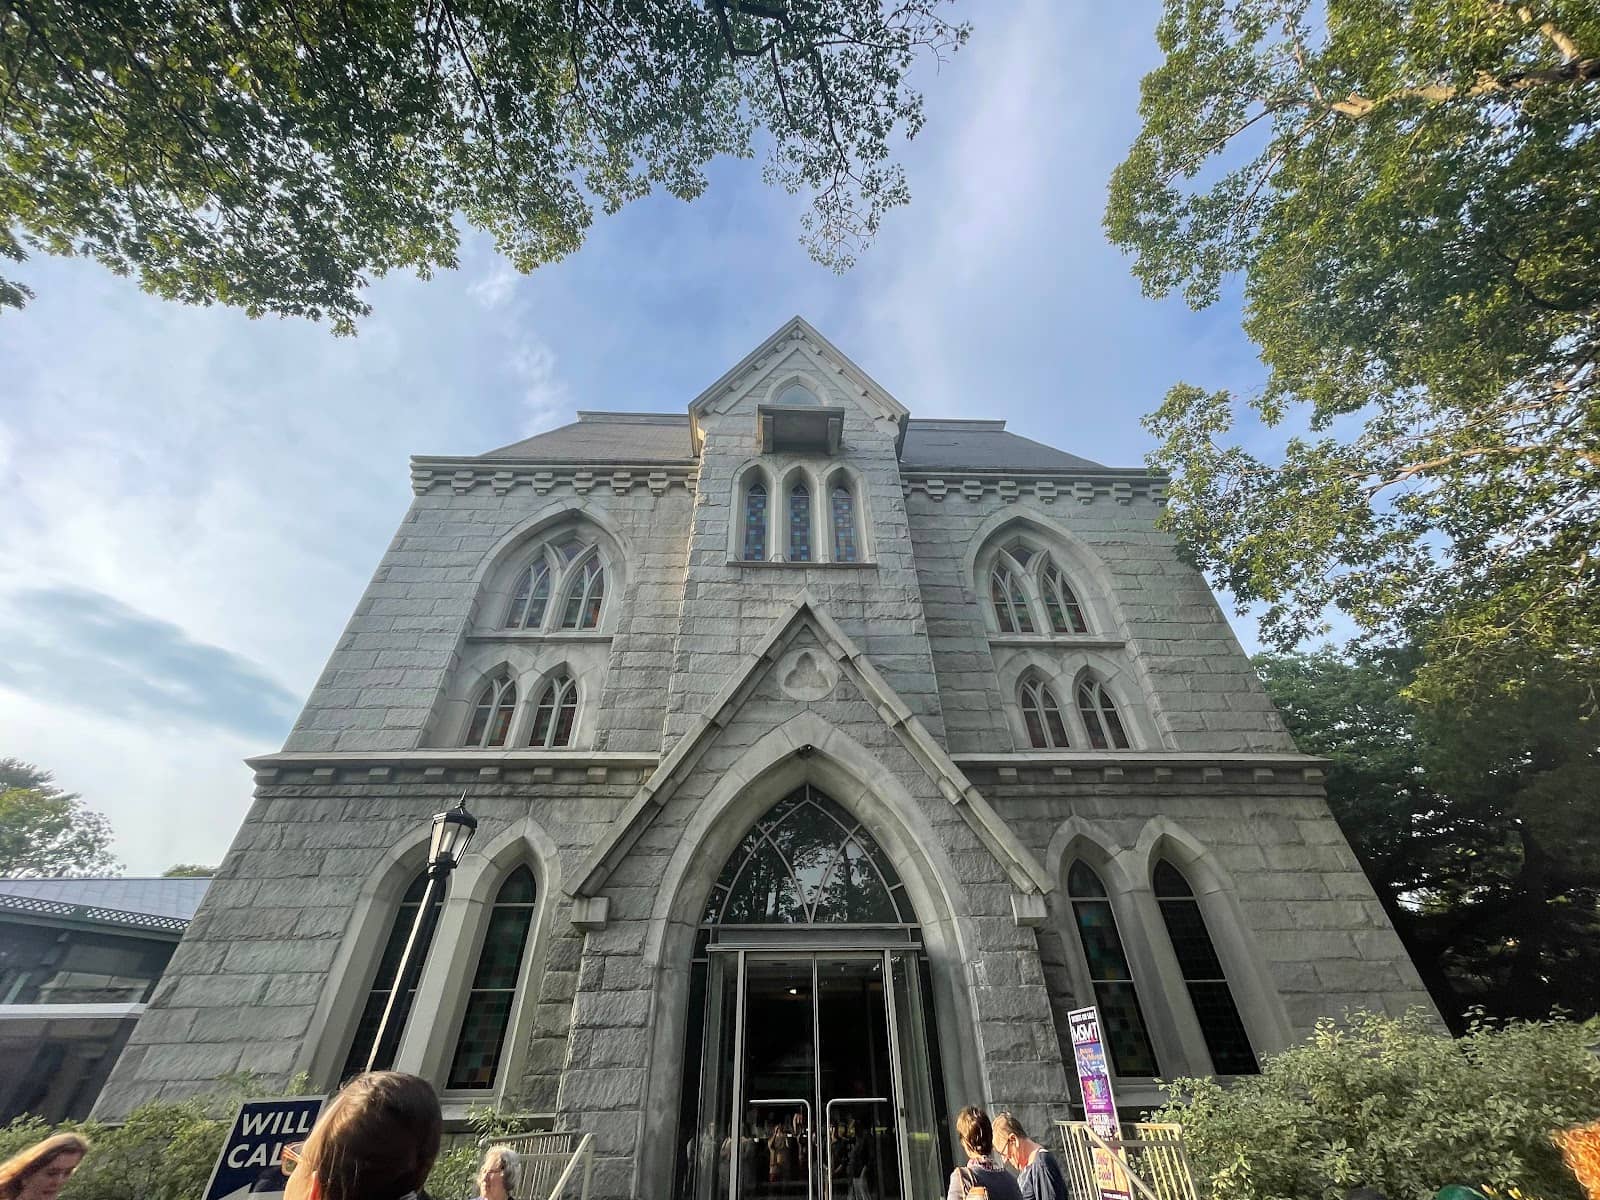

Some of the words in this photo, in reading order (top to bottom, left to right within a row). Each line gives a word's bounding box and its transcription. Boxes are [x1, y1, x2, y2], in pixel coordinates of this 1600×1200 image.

[1071, 1022, 1098, 1042] MSMT
[242, 1110, 310, 1136] WILL
[227, 1142, 283, 1168] CAL
